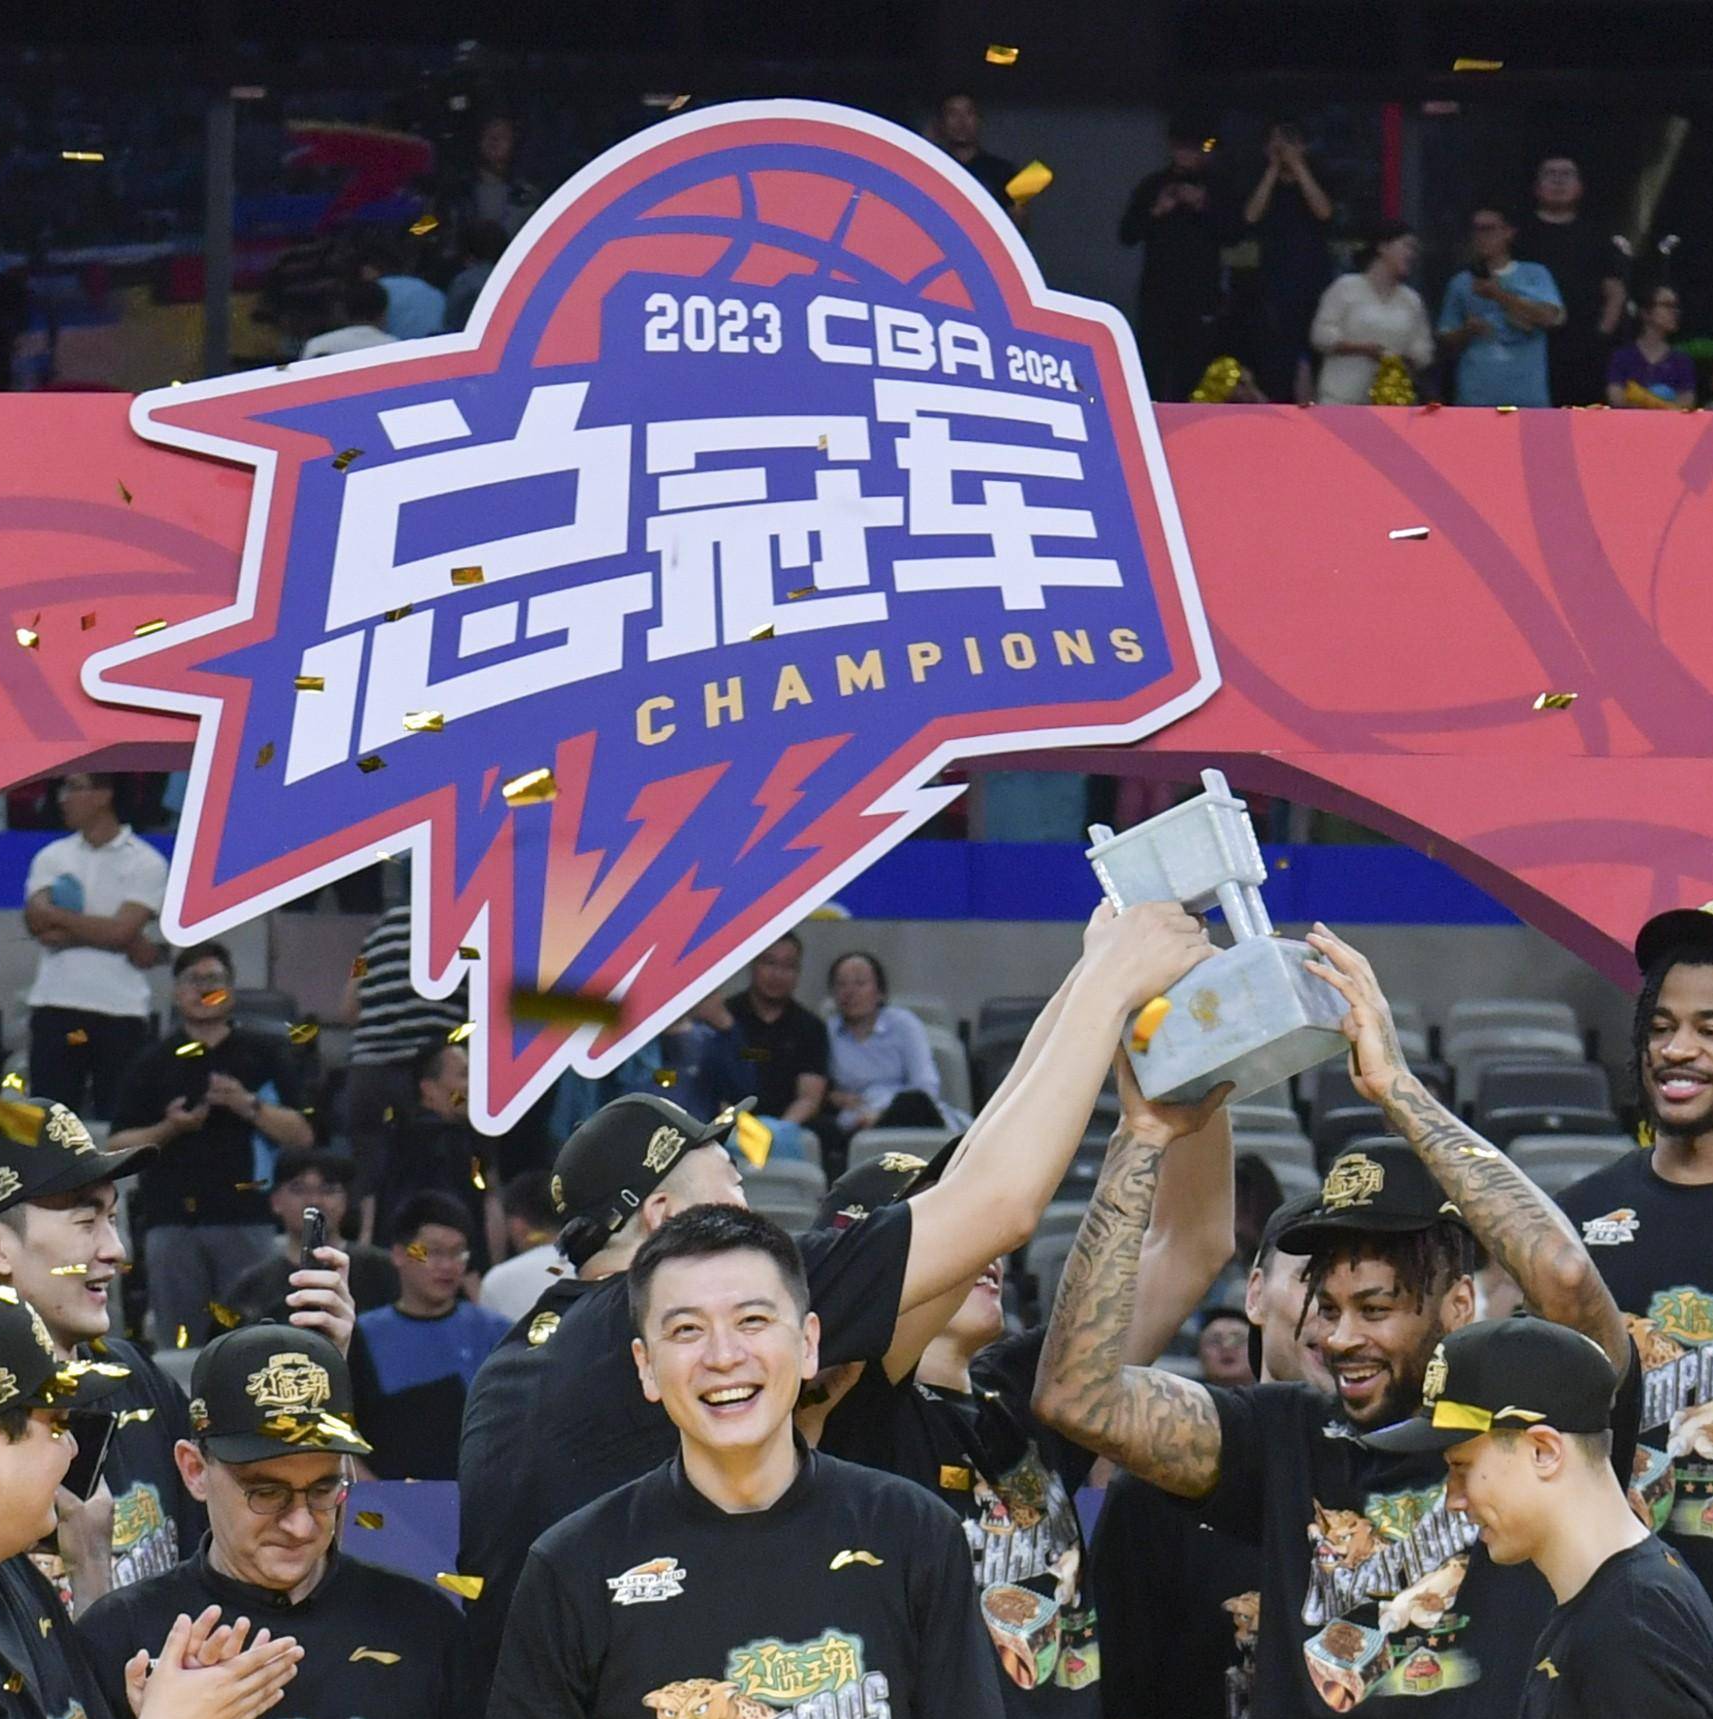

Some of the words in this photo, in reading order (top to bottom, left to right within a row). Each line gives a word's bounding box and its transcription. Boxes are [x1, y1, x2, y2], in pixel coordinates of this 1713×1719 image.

[643, 293, 784, 355] 2023
[805, 294, 993, 381] CBA
[1006, 344, 1079, 391] 2024
[284, 377, 1123, 787] 总冠军
[635, 626, 1146, 748] CHAMPIONS
